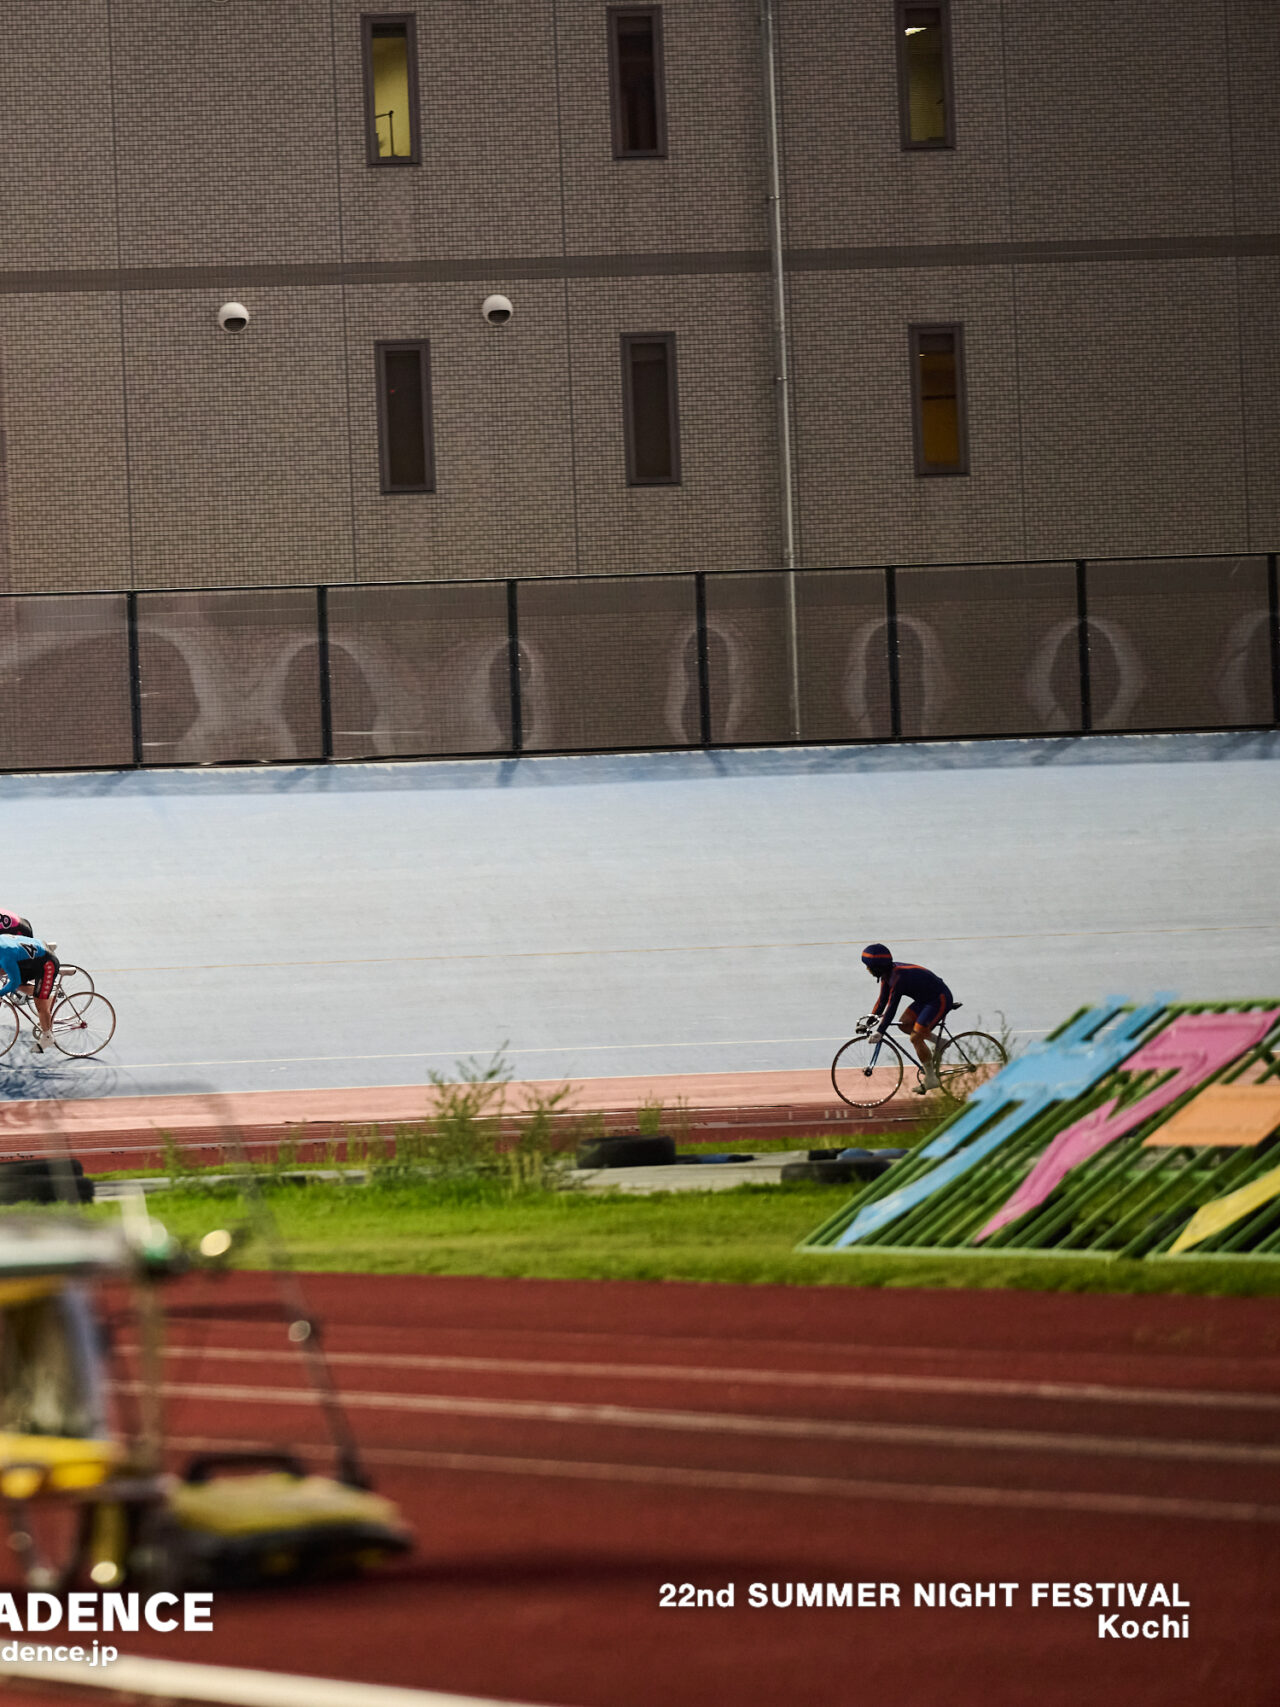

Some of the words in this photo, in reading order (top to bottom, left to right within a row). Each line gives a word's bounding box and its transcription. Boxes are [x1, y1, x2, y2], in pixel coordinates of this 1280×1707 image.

[20, 943, 38, 959] 4
[836, 991, 1280, 1256] サマー
